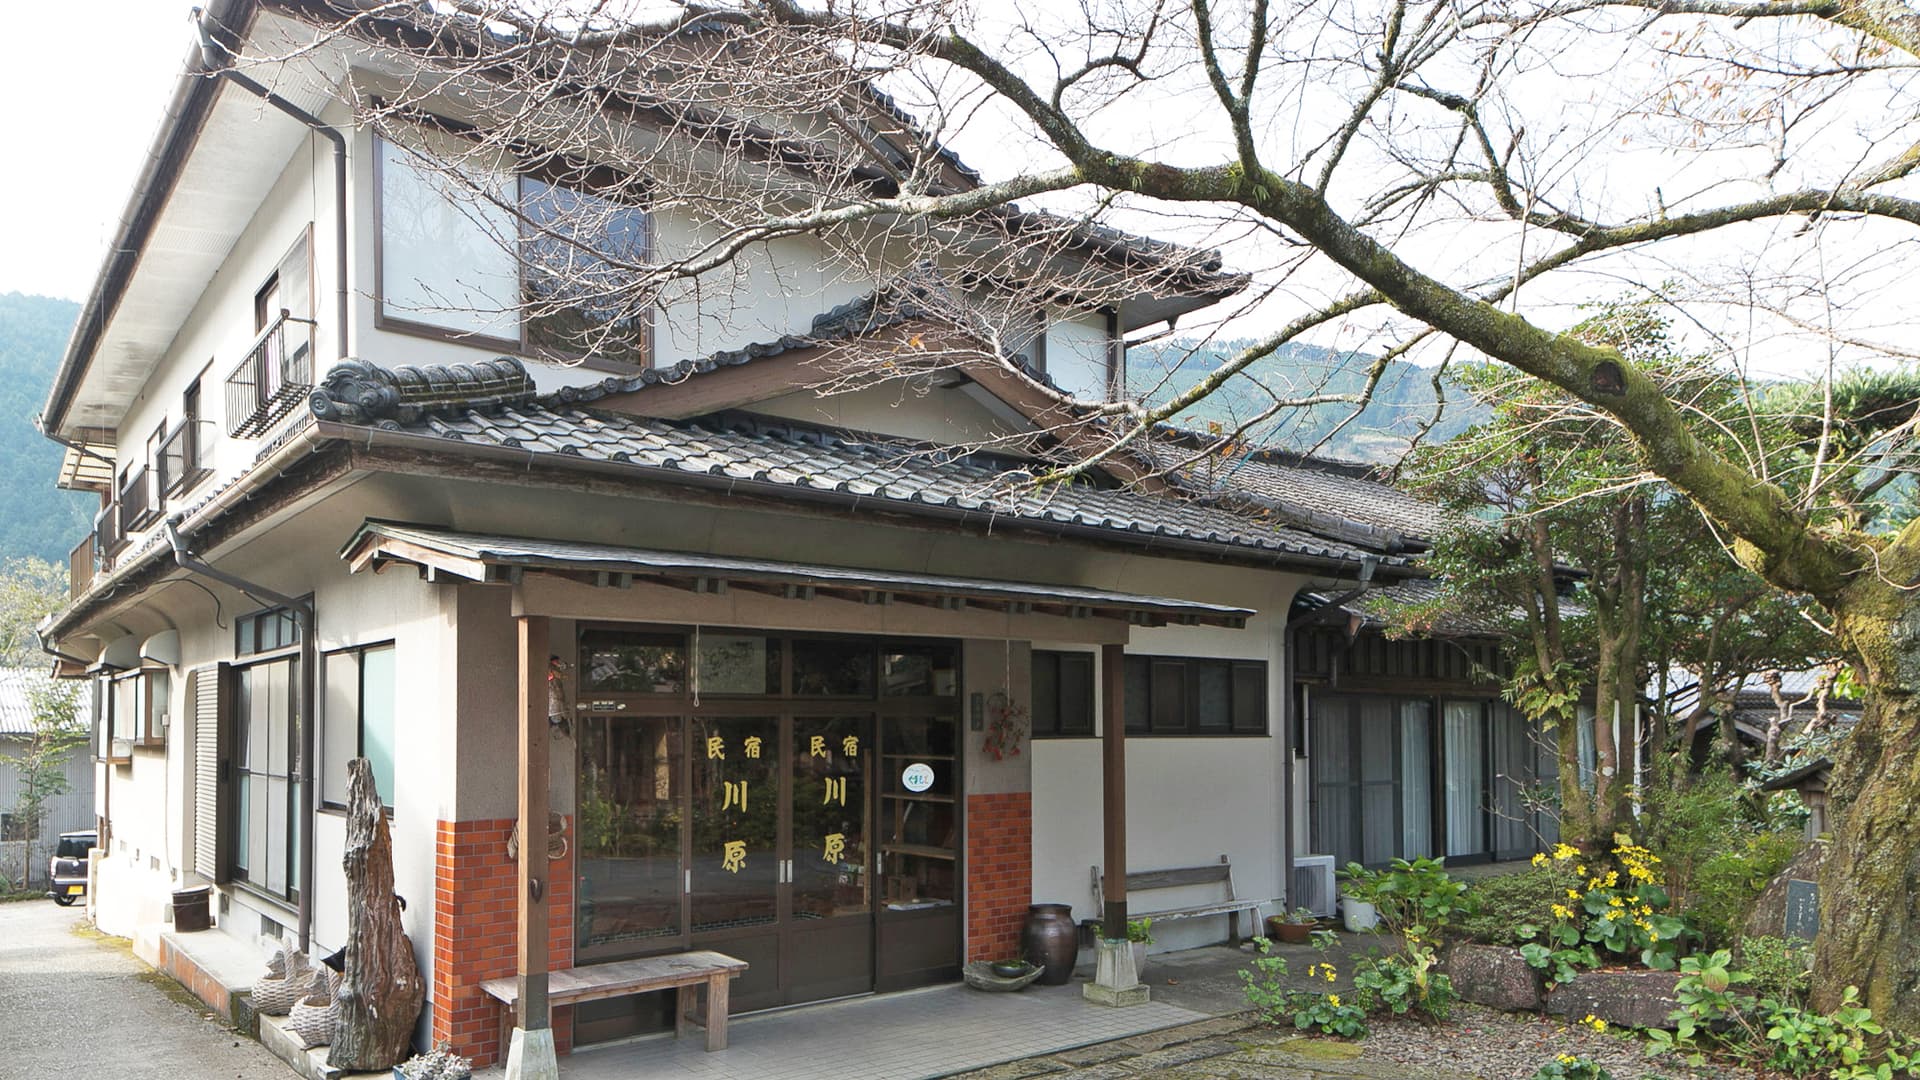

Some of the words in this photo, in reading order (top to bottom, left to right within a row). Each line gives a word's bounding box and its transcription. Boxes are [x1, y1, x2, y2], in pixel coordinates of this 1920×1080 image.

[707, 735, 763, 760] 民宿
[810, 735, 860, 759] 民宿
[721, 780, 748, 873] 川原
[822, 776, 847, 865] 川原
